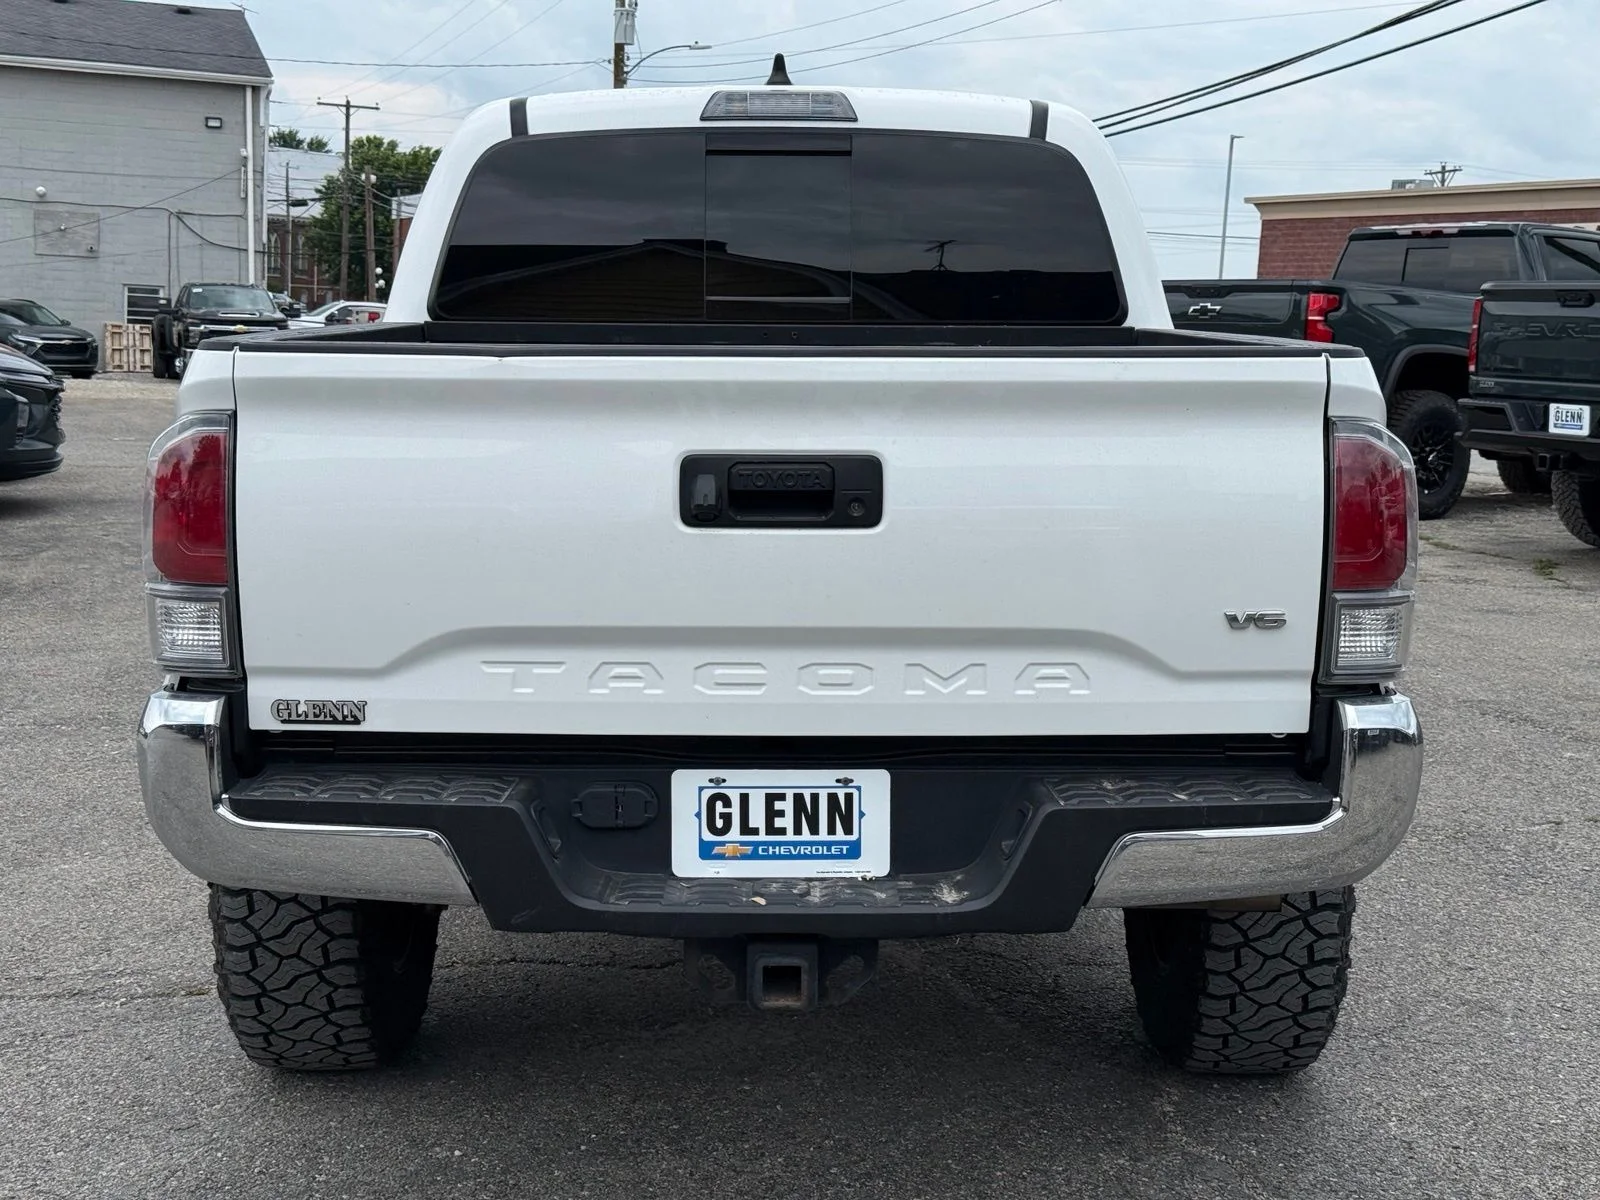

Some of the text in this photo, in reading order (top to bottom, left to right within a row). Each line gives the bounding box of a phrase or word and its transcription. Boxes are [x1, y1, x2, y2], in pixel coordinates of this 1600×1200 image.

[1554, 410, 1583, 424] GLENN
[738, 470, 826, 489] TOYOTA
[1224, 608, 1287, 630] V6
[480, 660, 1091, 695] TACOMA
[270, 699, 367, 722] GLENN
[705, 791, 854, 837] GLENN
[758, 845, 850, 855] CHEVROLET
